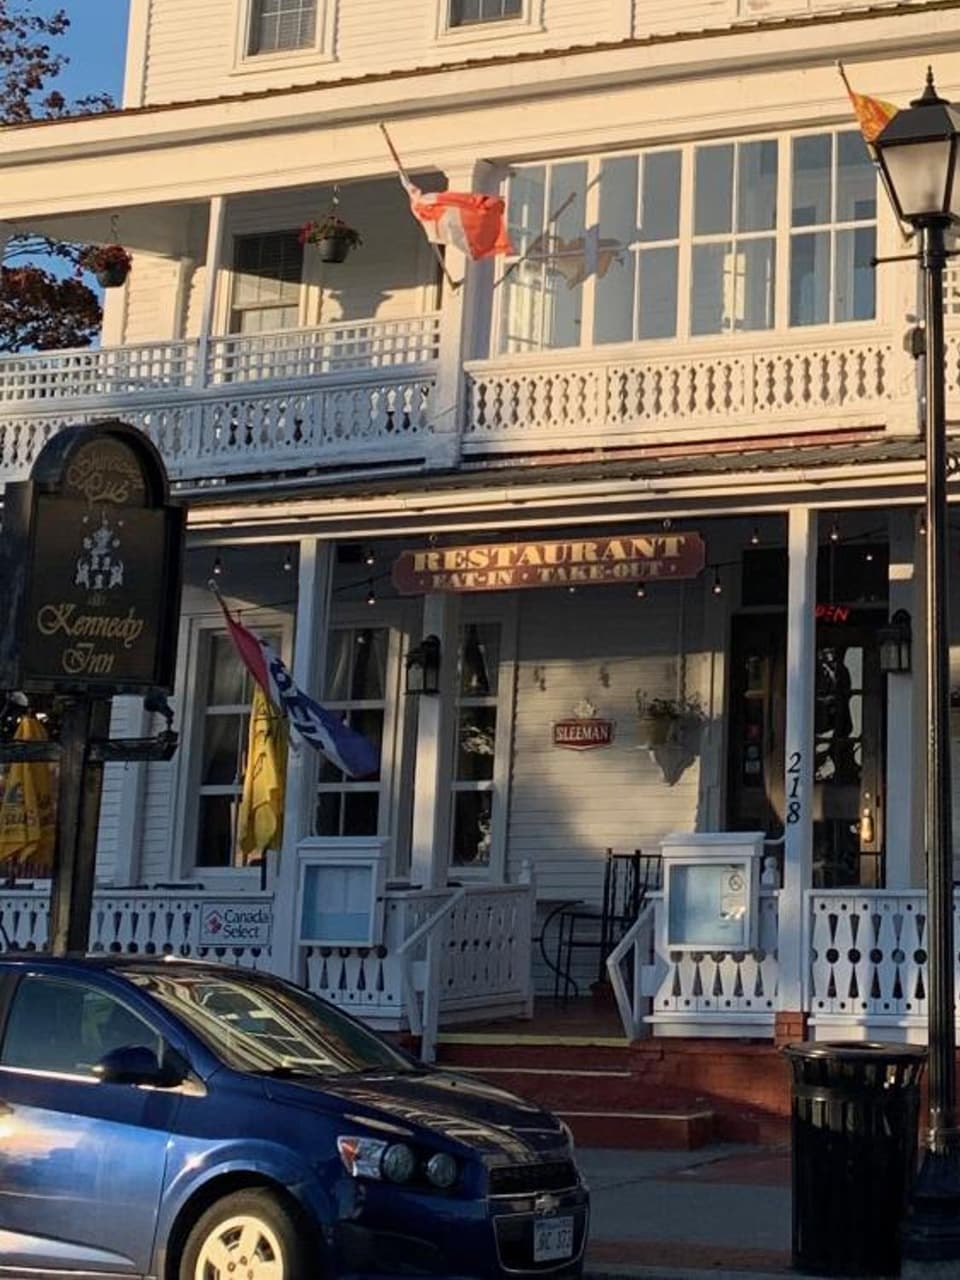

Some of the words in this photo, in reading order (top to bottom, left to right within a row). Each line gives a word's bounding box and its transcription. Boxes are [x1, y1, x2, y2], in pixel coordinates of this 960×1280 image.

[414, 536, 685, 571] RESTAURANT
[433, 570, 514, 588] EAT-IN
[537, 561, 662, 582] TAKE-OUT
[38, 603, 144, 648] Kennedy
[63, 642, 115, 673] Inn
[556, 725, 609, 741] SLEEMAN
[787, 751, 802, 824] 218
[224, 908, 270, 924] Canada
[224, 923, 259, 939] Select
